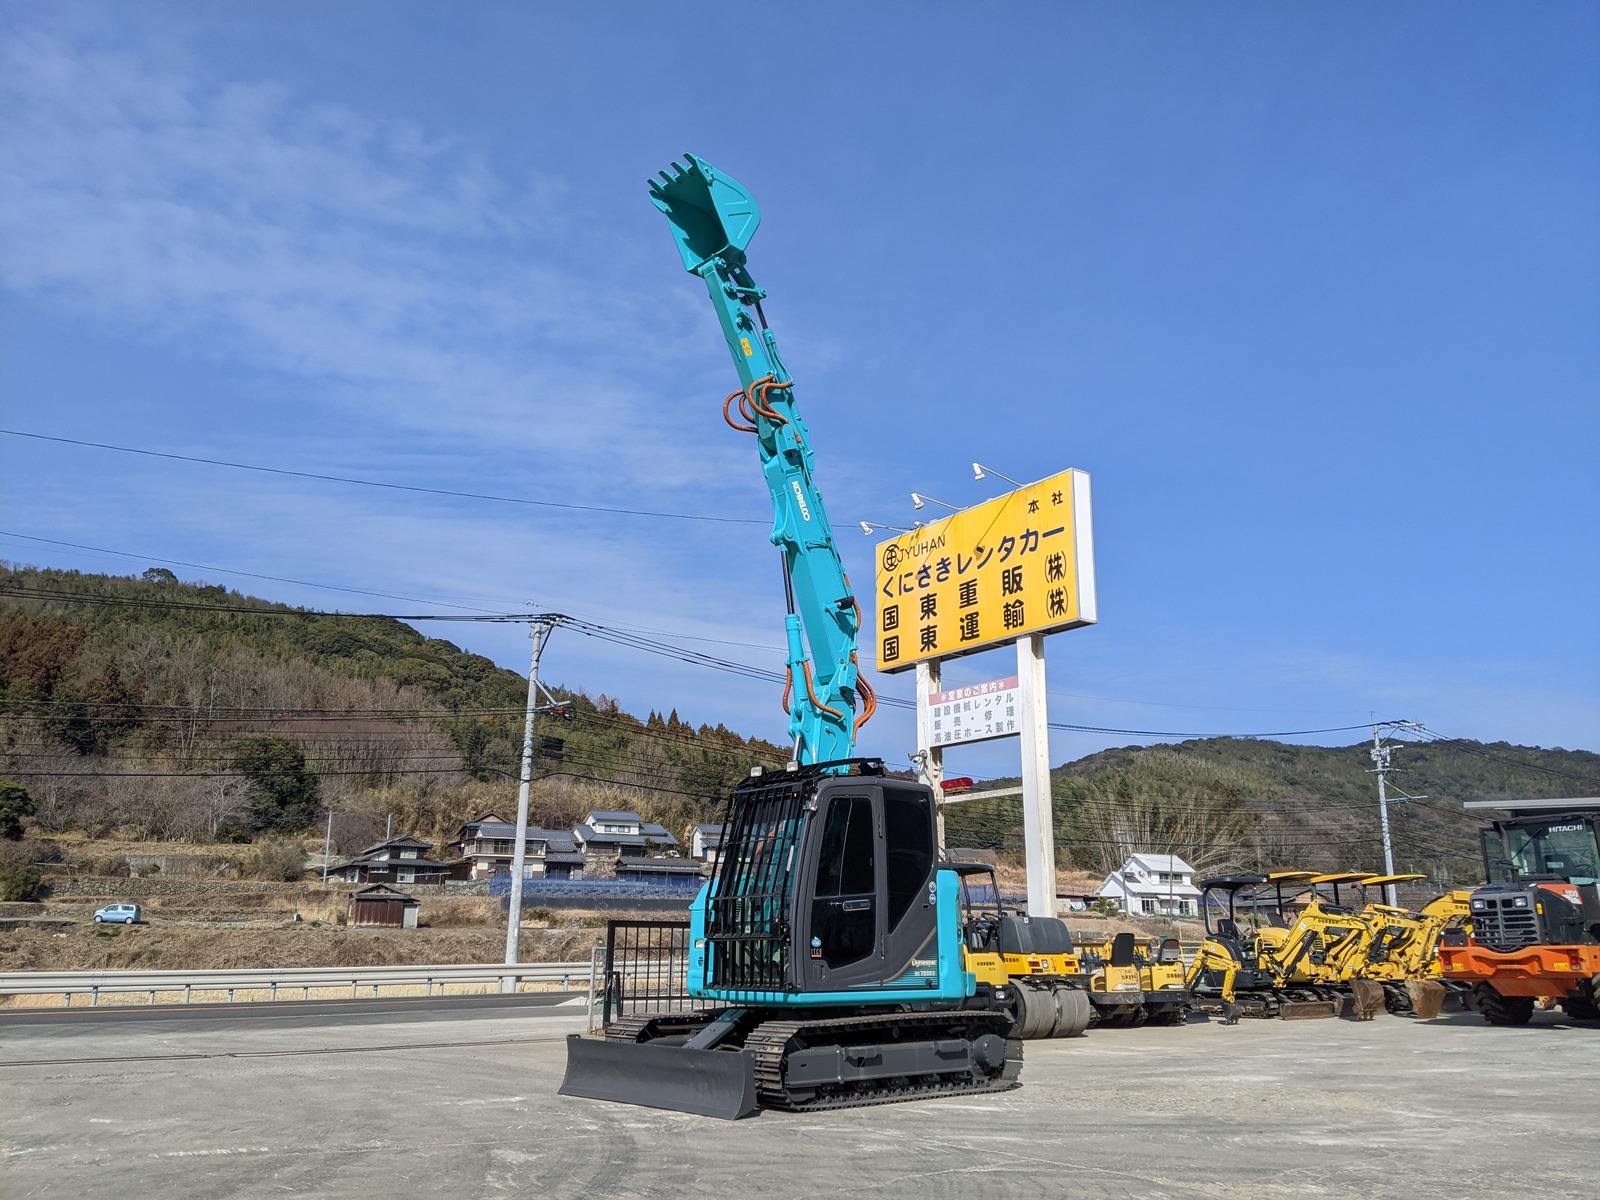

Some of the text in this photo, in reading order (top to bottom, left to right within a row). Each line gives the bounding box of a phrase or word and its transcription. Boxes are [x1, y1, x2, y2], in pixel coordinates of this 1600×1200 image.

[791, 480, 811, 521] KOBELCO
[1028, 490, 1064, 514] 本社
[882, 526, 1065, 598] くにさきレンタカー
[897, 534, 946, 563] JYUHAN
[933, 692, 1014, 718] 建設機械レンタル
[1548, 824, 1583, 833] HITACHI
